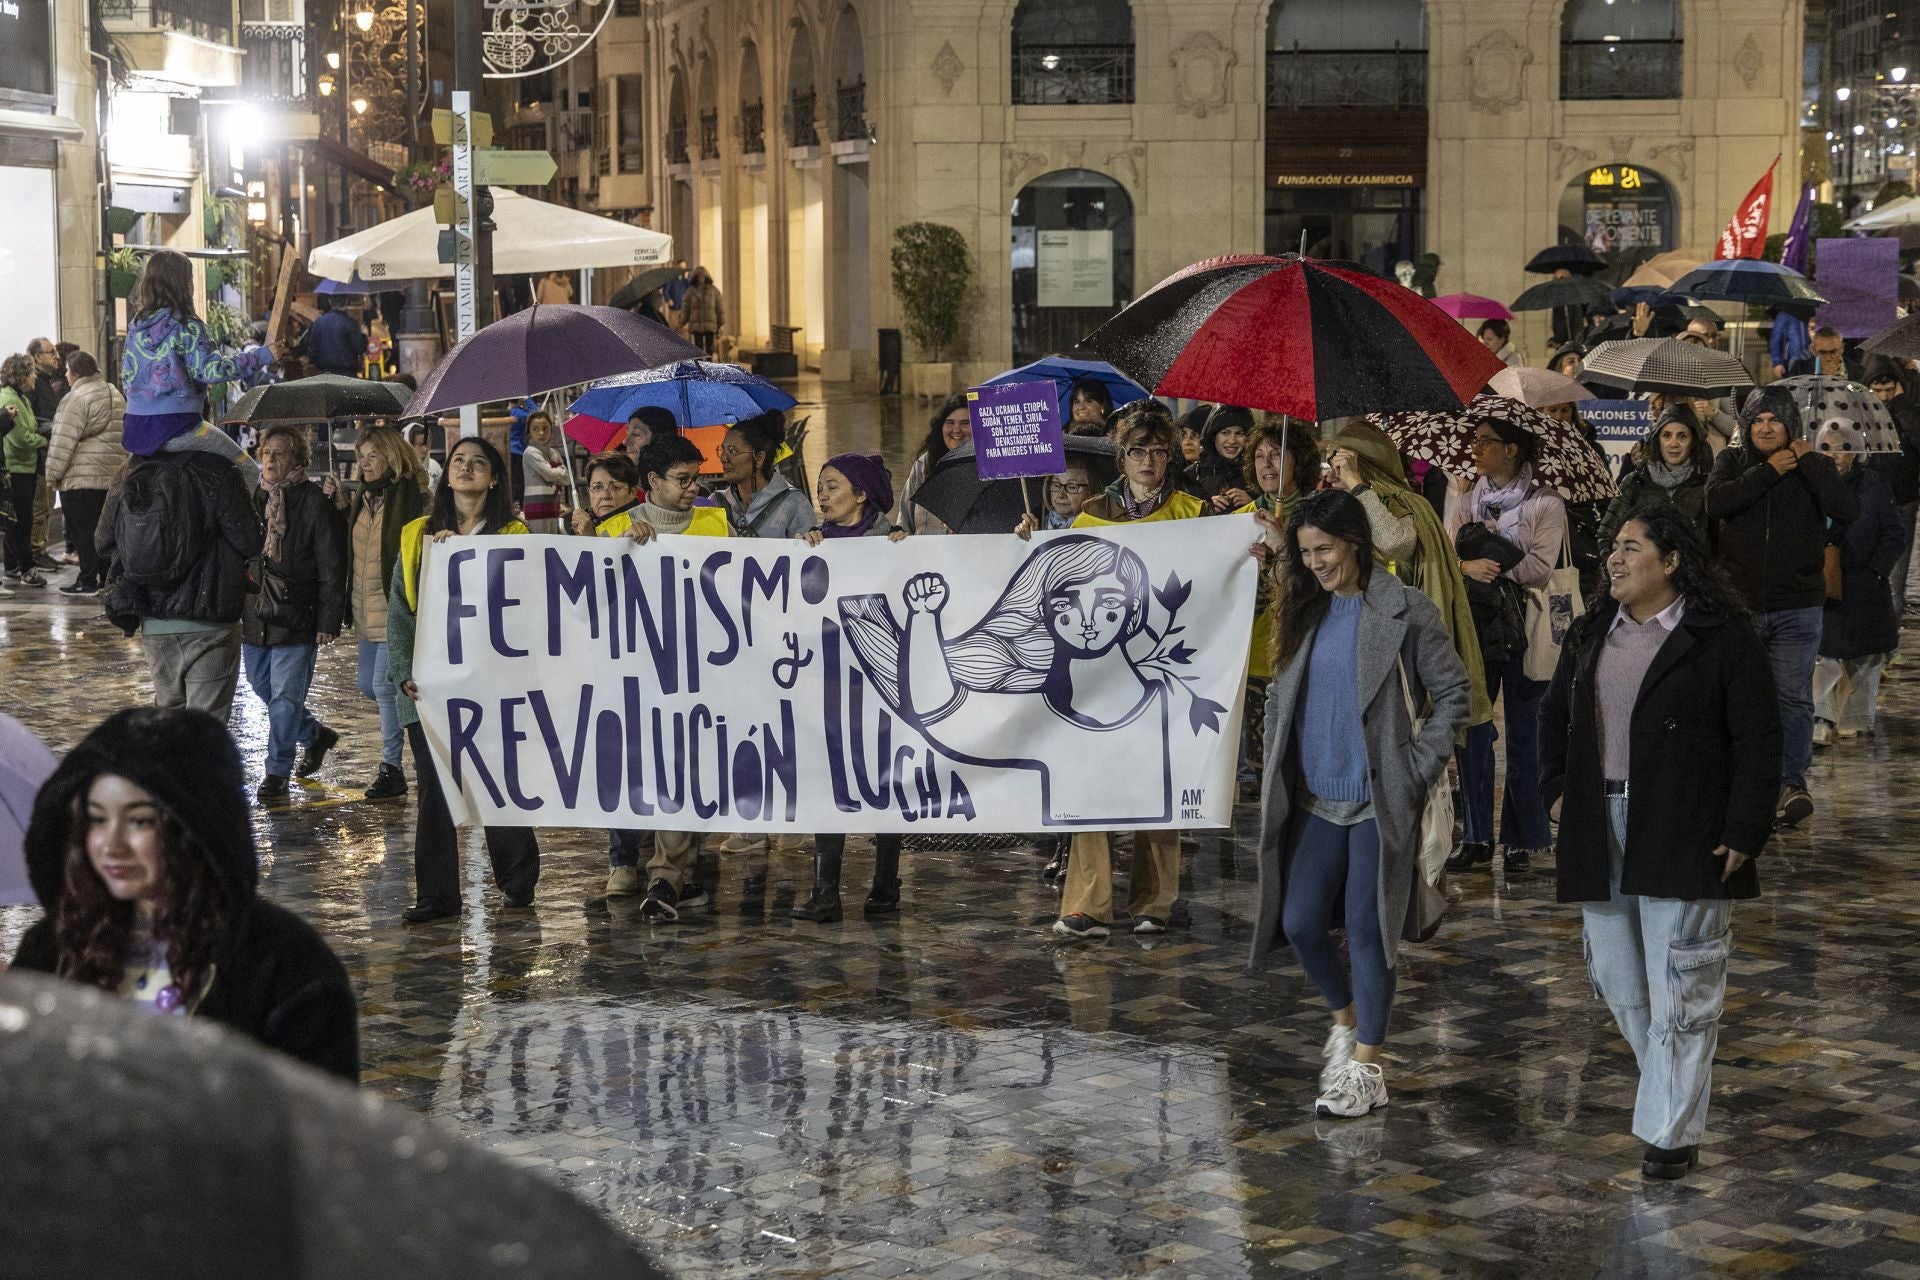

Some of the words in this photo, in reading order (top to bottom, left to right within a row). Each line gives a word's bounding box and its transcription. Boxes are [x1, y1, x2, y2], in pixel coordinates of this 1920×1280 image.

[1277, 174, 1342, 185] FUNDACIÓN
[1343, 175, 1413, 185] CAJAMURCIA
[979, 407, 995, 417] GAZA,
[995, 404, 1023, 415] UCRANIA,
[1023, 400, 1050, 412] ETIOPÍA,
[1003, 414, 1025, 425] YEMEN,
[1026, 413, 1049, 423] SIRIA...
[991, 427, 1003, 436] SON
[1004, 423, 1041, 435] CONFLICTOS
[995, 434, 1039, 446] DEVASTADORES
[986, 448, 1001, 458] PARA
[1001, 445, 1028, 456] MUJERES
[1027, 445, 1033, 454] Y
[1033, 442, 1053, 454] NIÑAS
[822, 616, 976, 823] LUCHA
[1181, 789, 1205, 806] AM
[1181, 809, 1206, 820] INTE
